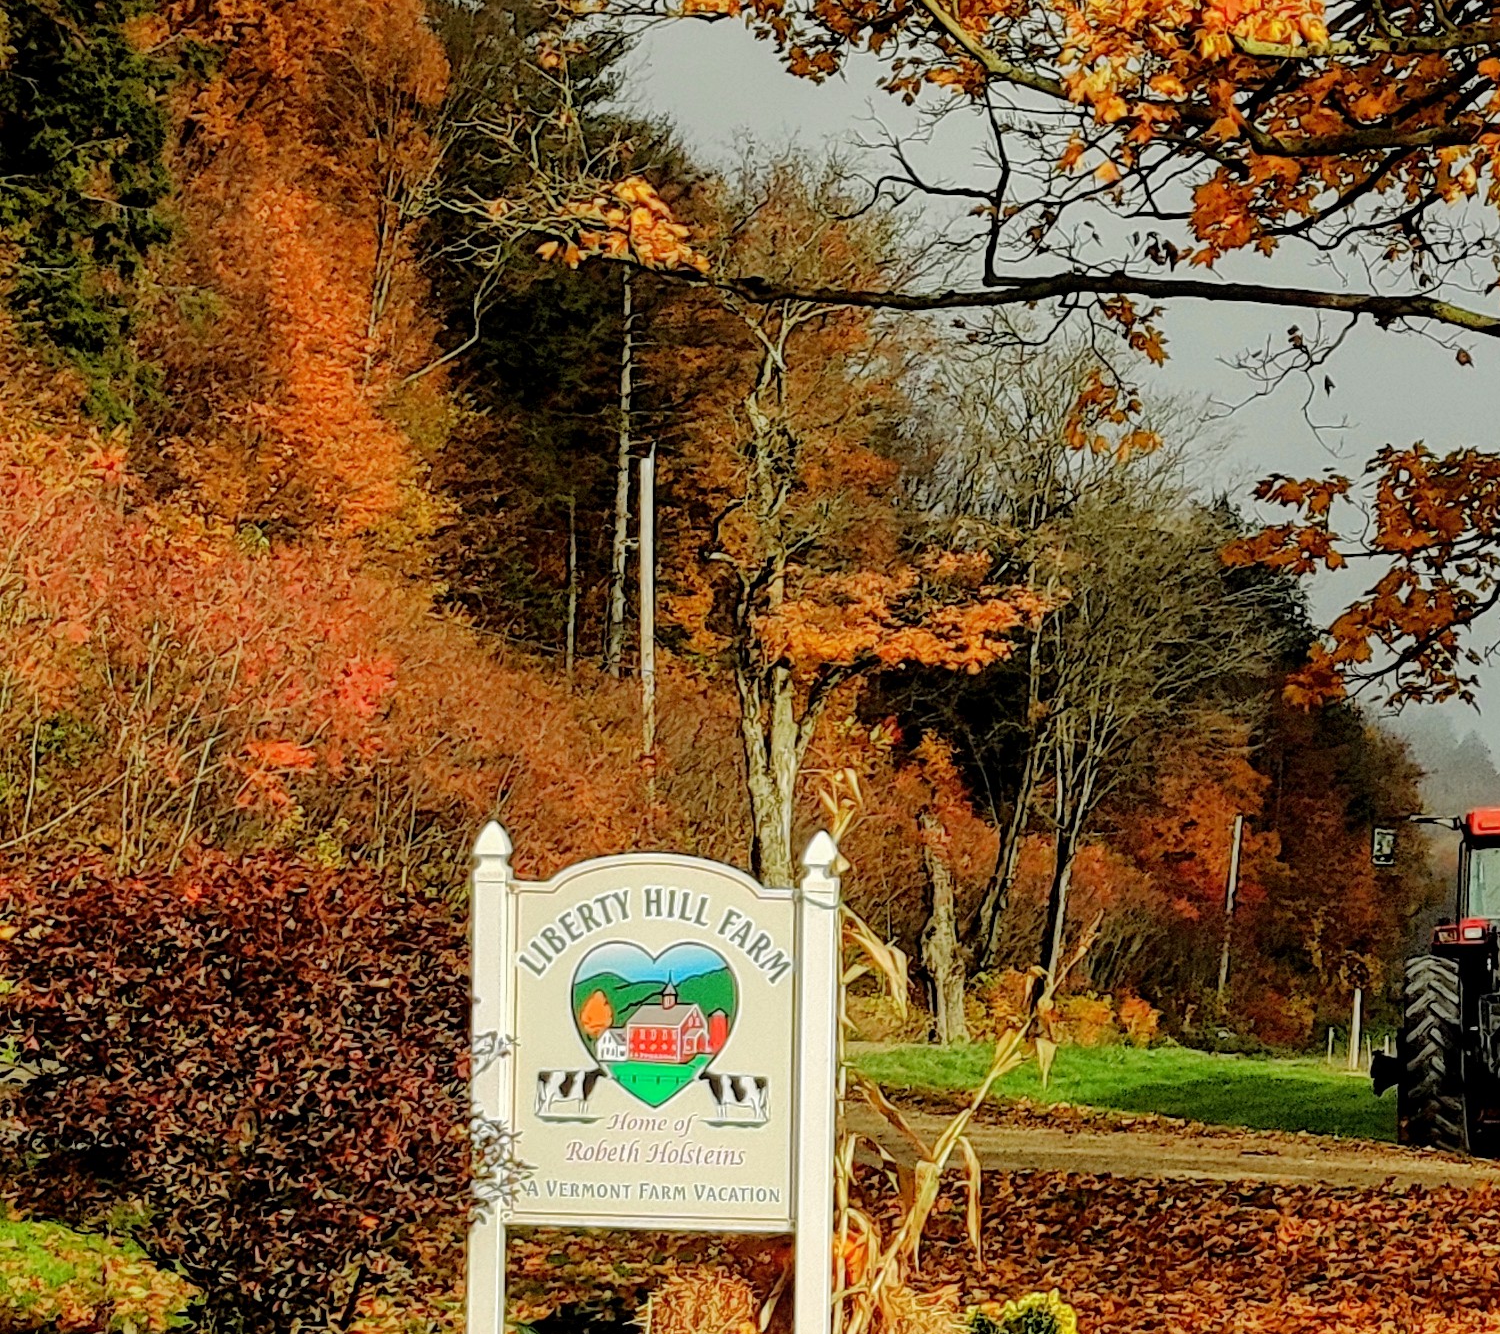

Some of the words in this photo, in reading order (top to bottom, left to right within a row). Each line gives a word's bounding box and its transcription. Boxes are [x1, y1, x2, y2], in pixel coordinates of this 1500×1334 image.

[519, 889, 630, 977] LIBERTY
[644, 888, 709, 927] HILL
[717, 908, 792, 984] FARM
[606, 1113, 668, 1132] Home
[674, 1113, 698, 1138] of
[565, 1139, 640, 1163] Robeth
[645, 1141, 747, 1166] Holsteins
[525, 1180, 539, 1197] A
[546, 1180, 633, 1200] VERMONT
[639, 1182, 687, 1201] FARM
[693, 1184, 781, 1203] VACATION
